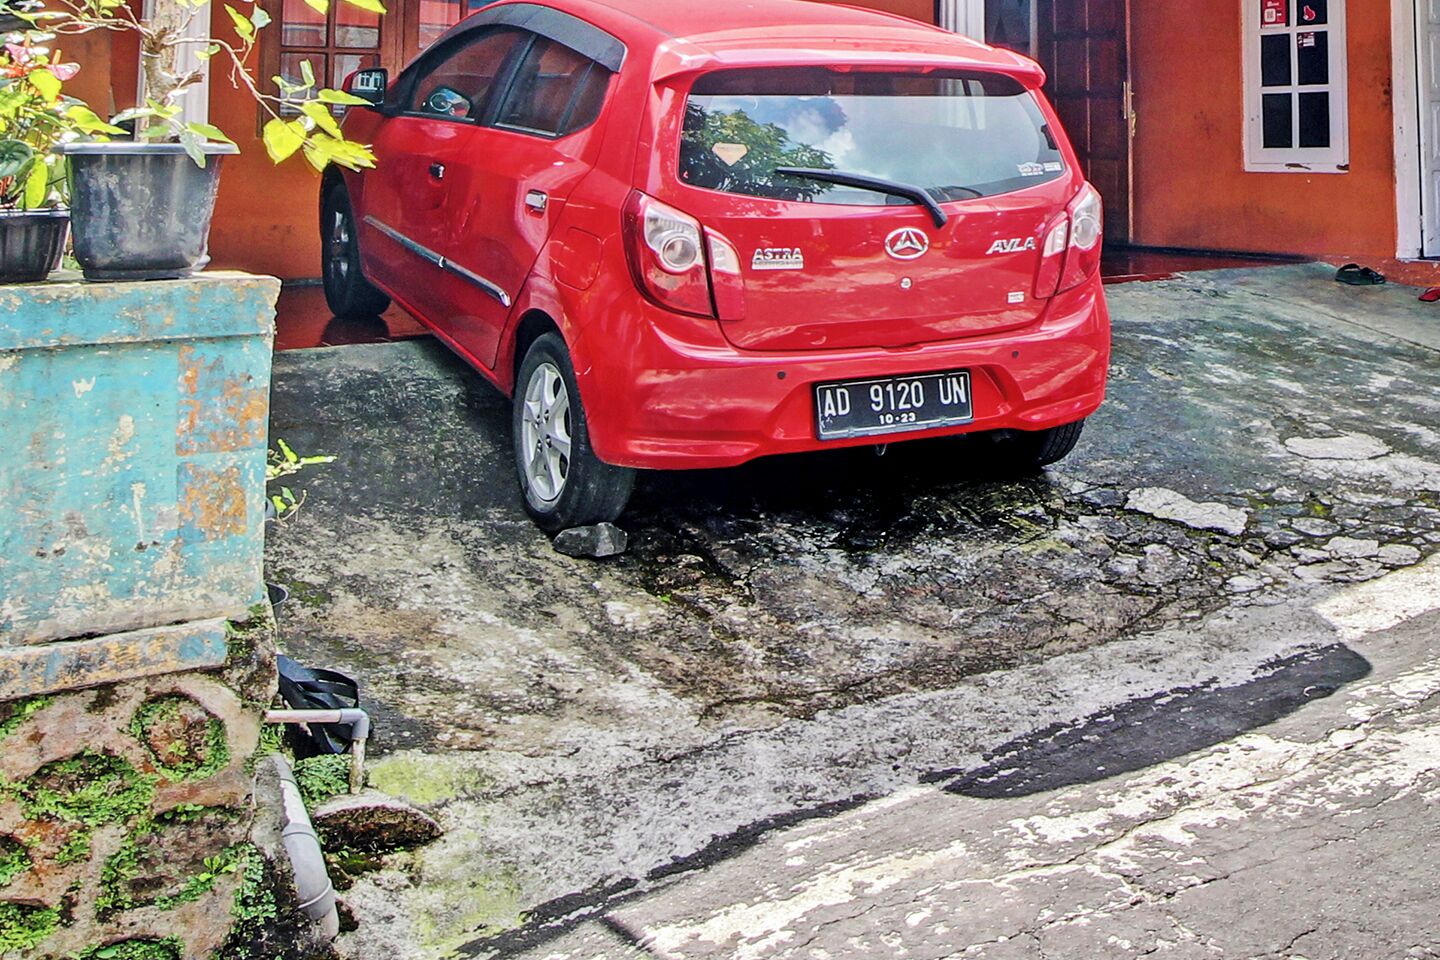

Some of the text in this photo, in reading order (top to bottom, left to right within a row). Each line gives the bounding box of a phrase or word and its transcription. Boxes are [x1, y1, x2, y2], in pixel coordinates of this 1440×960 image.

[752, 247, 804, 261] ASTRA
[824, 376, 967, 418] AD 9120 UN
